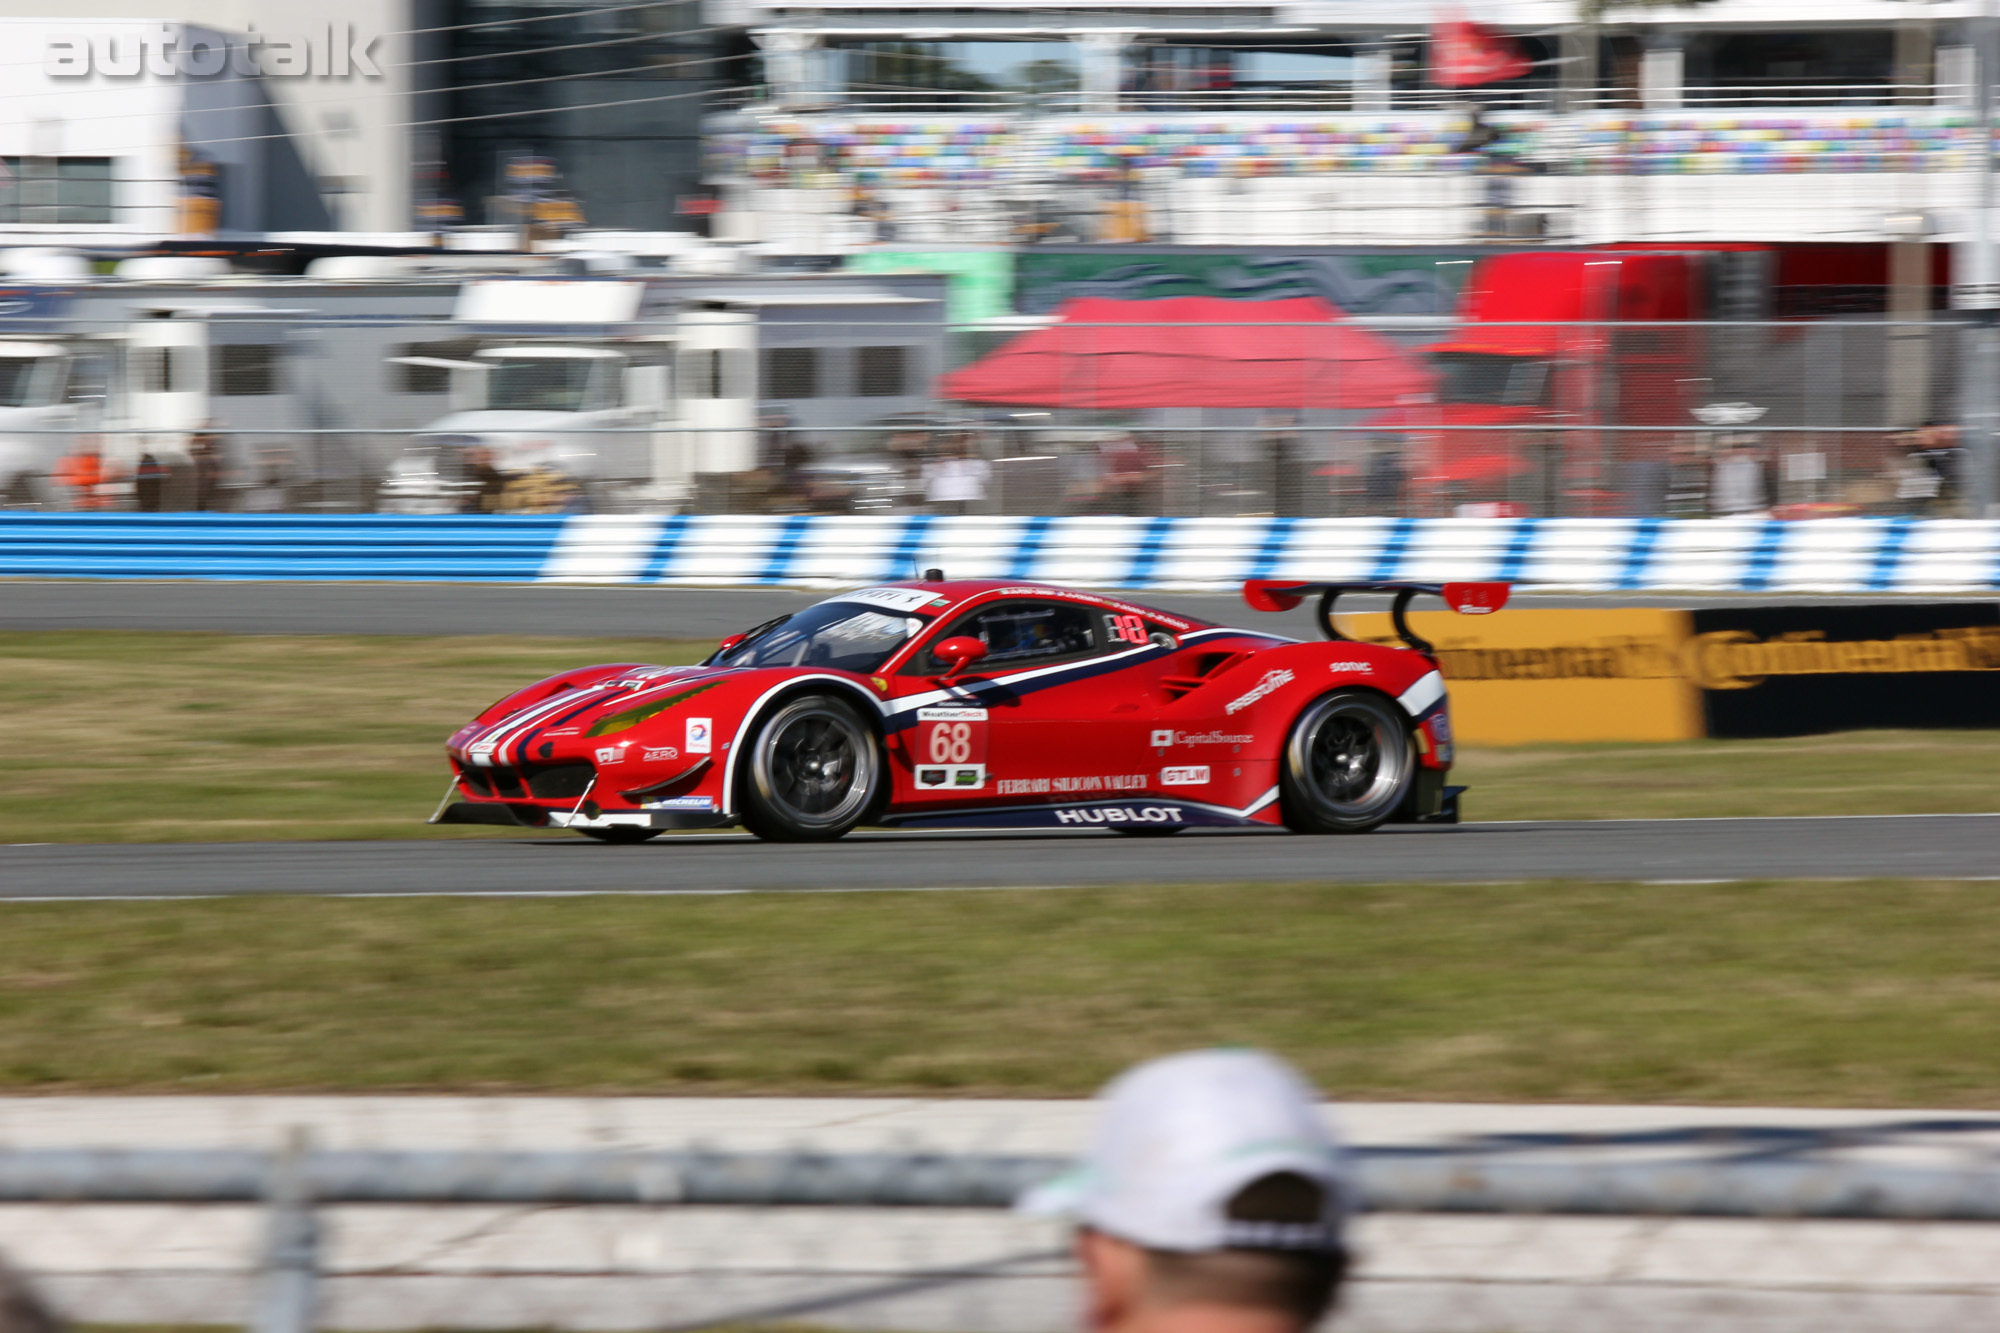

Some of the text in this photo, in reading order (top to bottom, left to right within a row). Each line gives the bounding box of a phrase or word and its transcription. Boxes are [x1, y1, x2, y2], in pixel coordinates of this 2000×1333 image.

[929, 722, 971, 764] 68
[996, 777, 1051, 794] FERRARI
[1103, 773, 1150, 790] VALLEY
[1054, 807, 1184, 824] HUBLOT
